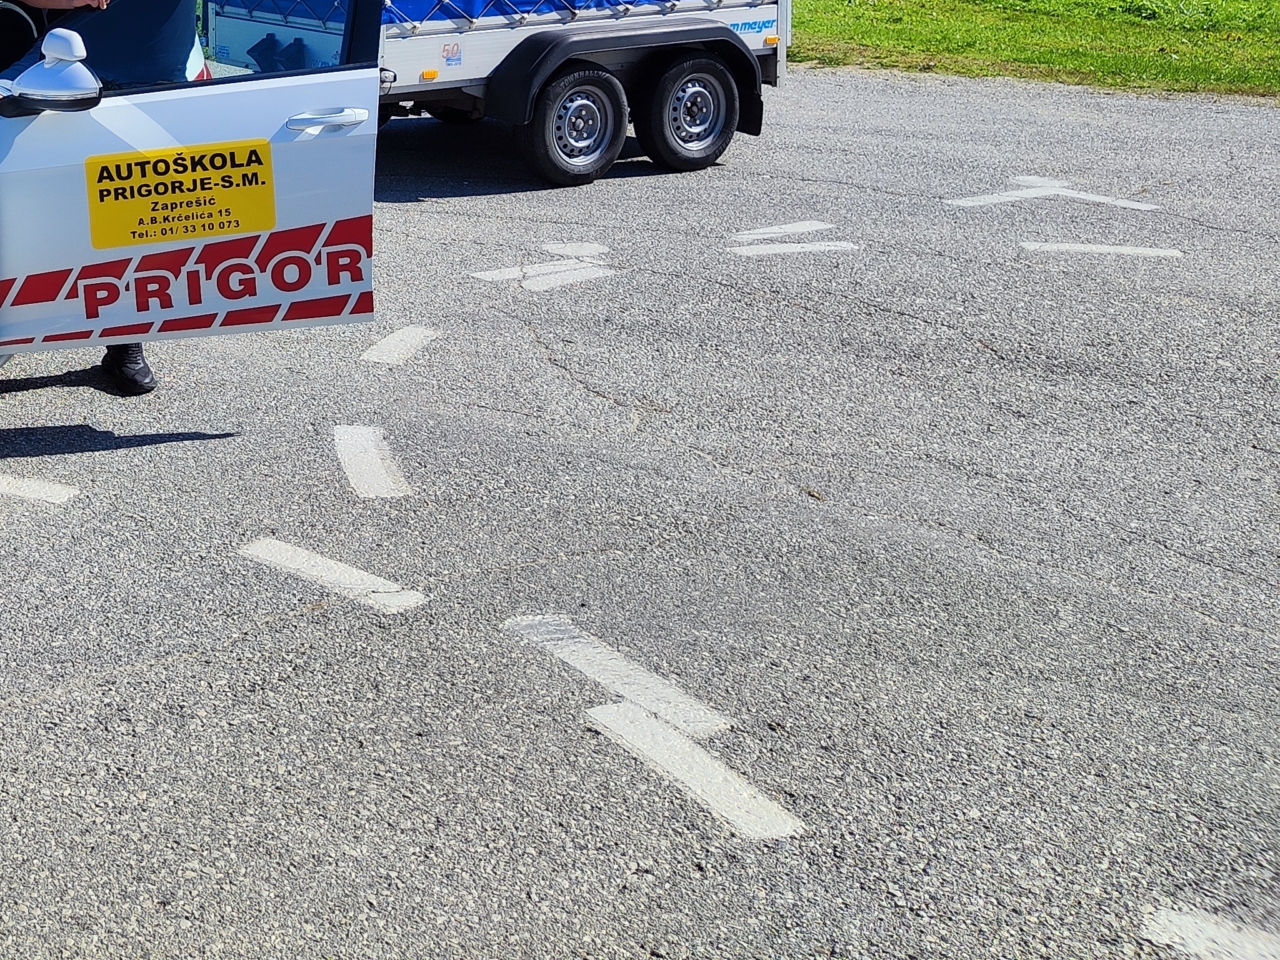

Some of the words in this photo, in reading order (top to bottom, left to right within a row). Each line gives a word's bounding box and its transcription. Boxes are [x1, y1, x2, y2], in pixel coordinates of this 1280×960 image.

[442, 42, 460, 59] 50
[96, 149, 264, 183] AUTOŠKOLA
[98, 172, 266, 202] PRIGORJE-S.M.
[150, 195, 216, 212] Zaprešić
[137, 209, 213, 226] A.B.Krčelića
[217, 208, 231, 218] 15
[130, 228, 157, 240] Tel.:
[160, 226, 179, 237] 01/
[182, 225, 196, 234] 33
[201, 223, 215, 232] 10
[218, 219, 240, 230] 073
[83, 249, 365, 320] PRIGOR
